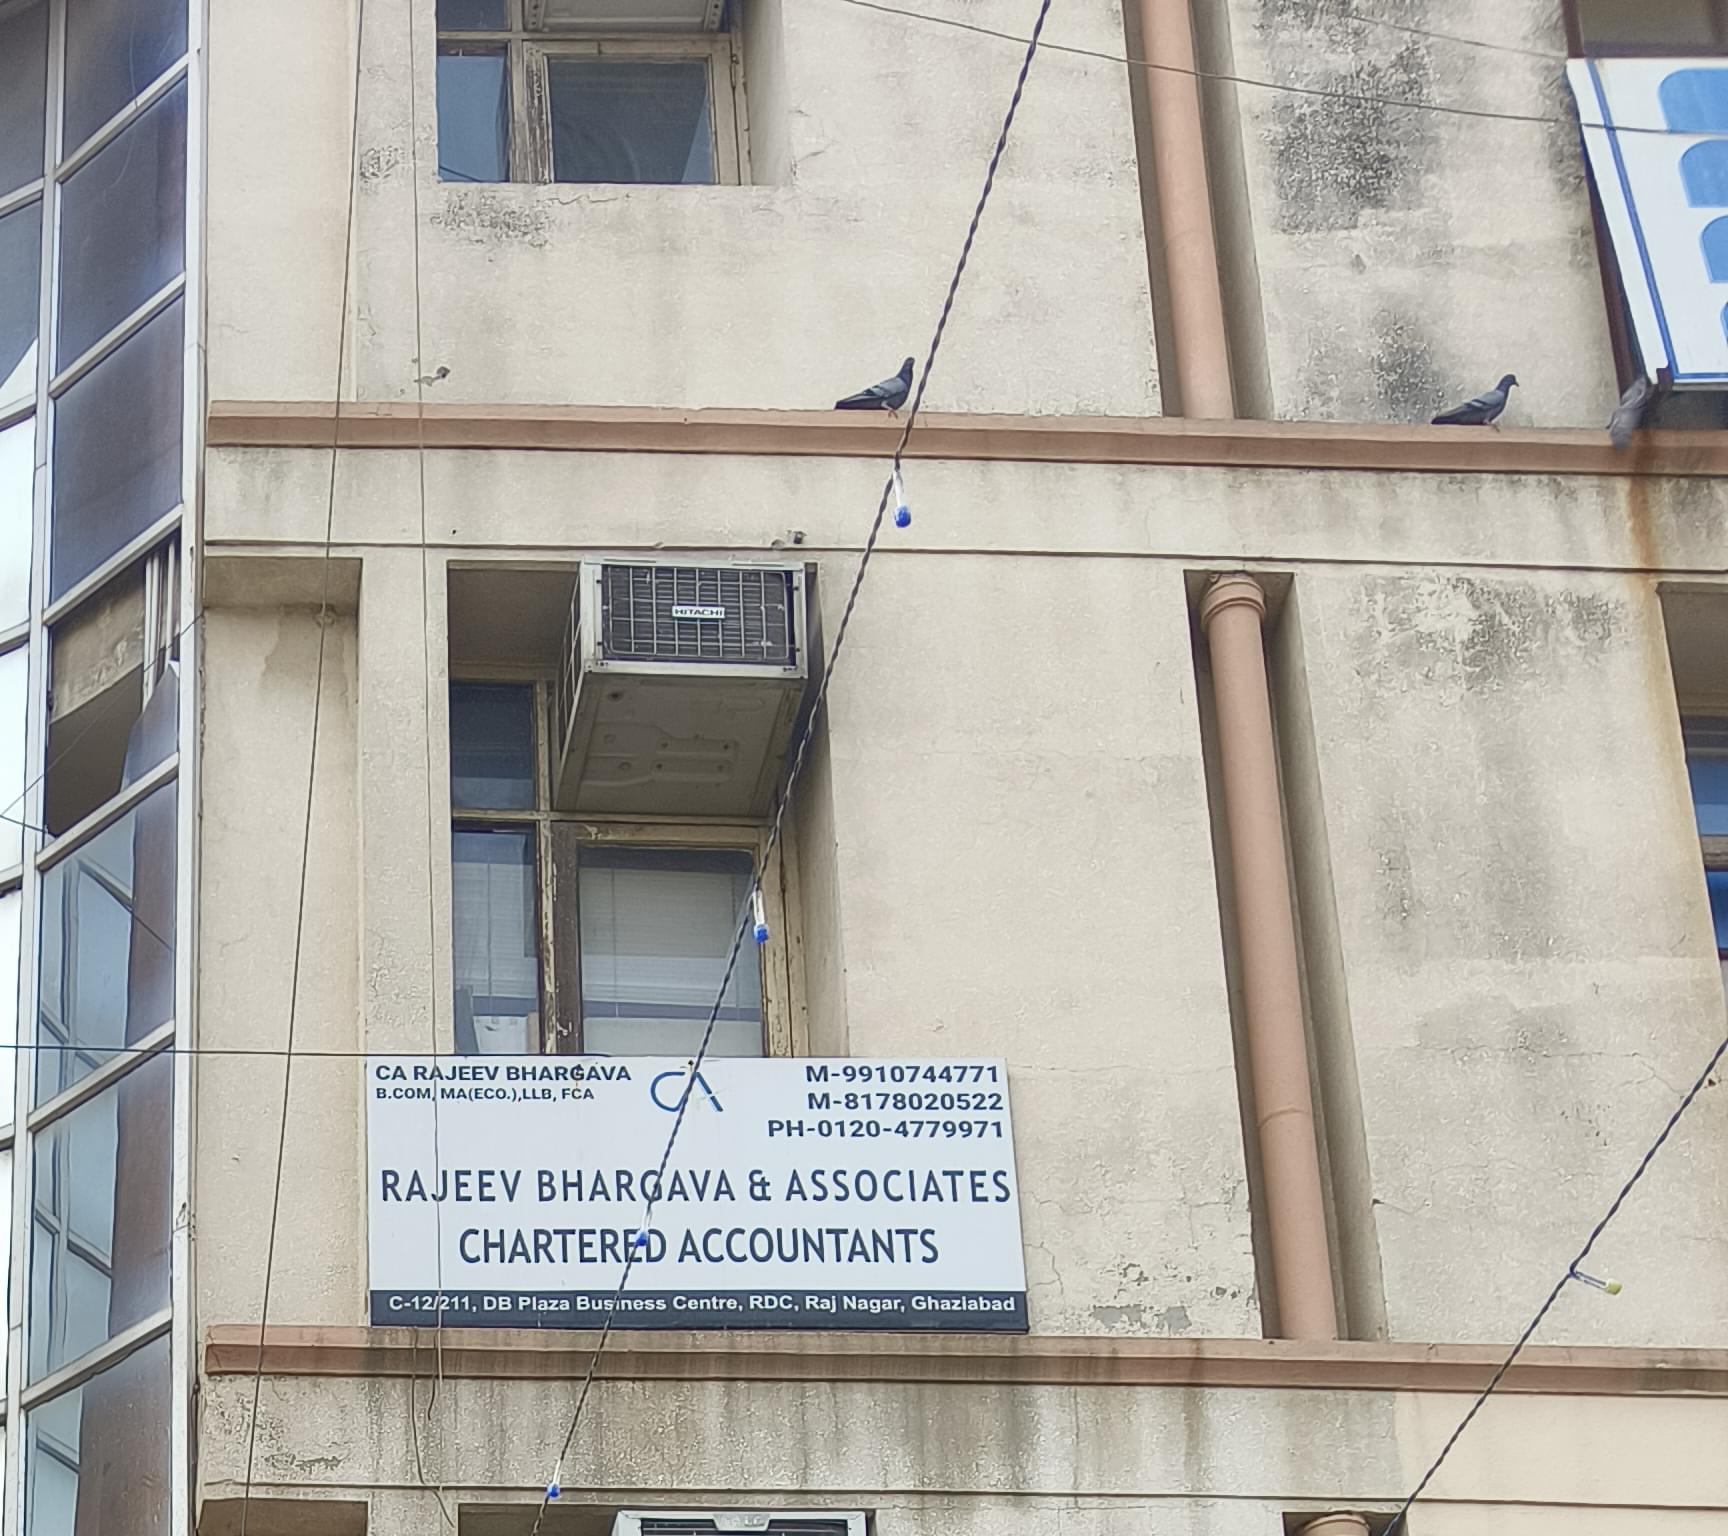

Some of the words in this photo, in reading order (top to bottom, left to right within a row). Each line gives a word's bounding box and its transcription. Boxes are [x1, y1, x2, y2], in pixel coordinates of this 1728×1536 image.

[376, 1066, 407, 1081] CA
[413, 1066, 500, 1081] RAJEEV
[506, 1066, 632, 1081] BHARGAVA
[806, 1065, 999, 1083] M-9910744771
[376, 1087, 435, 1101] B.COM,
[562, 1087, 594, 1100] FCA
[807, 1092, 1004, 1111] M-8178020522
[767, 1119, 1003, 1138] PH-0120-4779971
[381, 1169, 522, 1202] RAJEEV
[538, 1169, 735, 1202] BHARGAVA
[749, 1169, 771, 1202] &
[785, 1169, 1011, 1203] ASSOCIATES
[459, 1228, 667, 1264] CHARTERED
[678, 1227, 939, 1264] ACCOUNTANTS
[389, 1295, 477, 1313] C-12/211,
[483, 1296, 512, 1311] DB
[518, 1296, 570, 1311] Plaza
[576, 1296, 667, 1311] Business
[672, 1296, 743, 1314] Centre,
[749, 1296, 799, 1313] RDC,
[805, 1296, 836, 1314] Raj
[843, 1296, 906, 1314] Nagar,
[911, 1296, 1015, 1312] Ghaziabad
